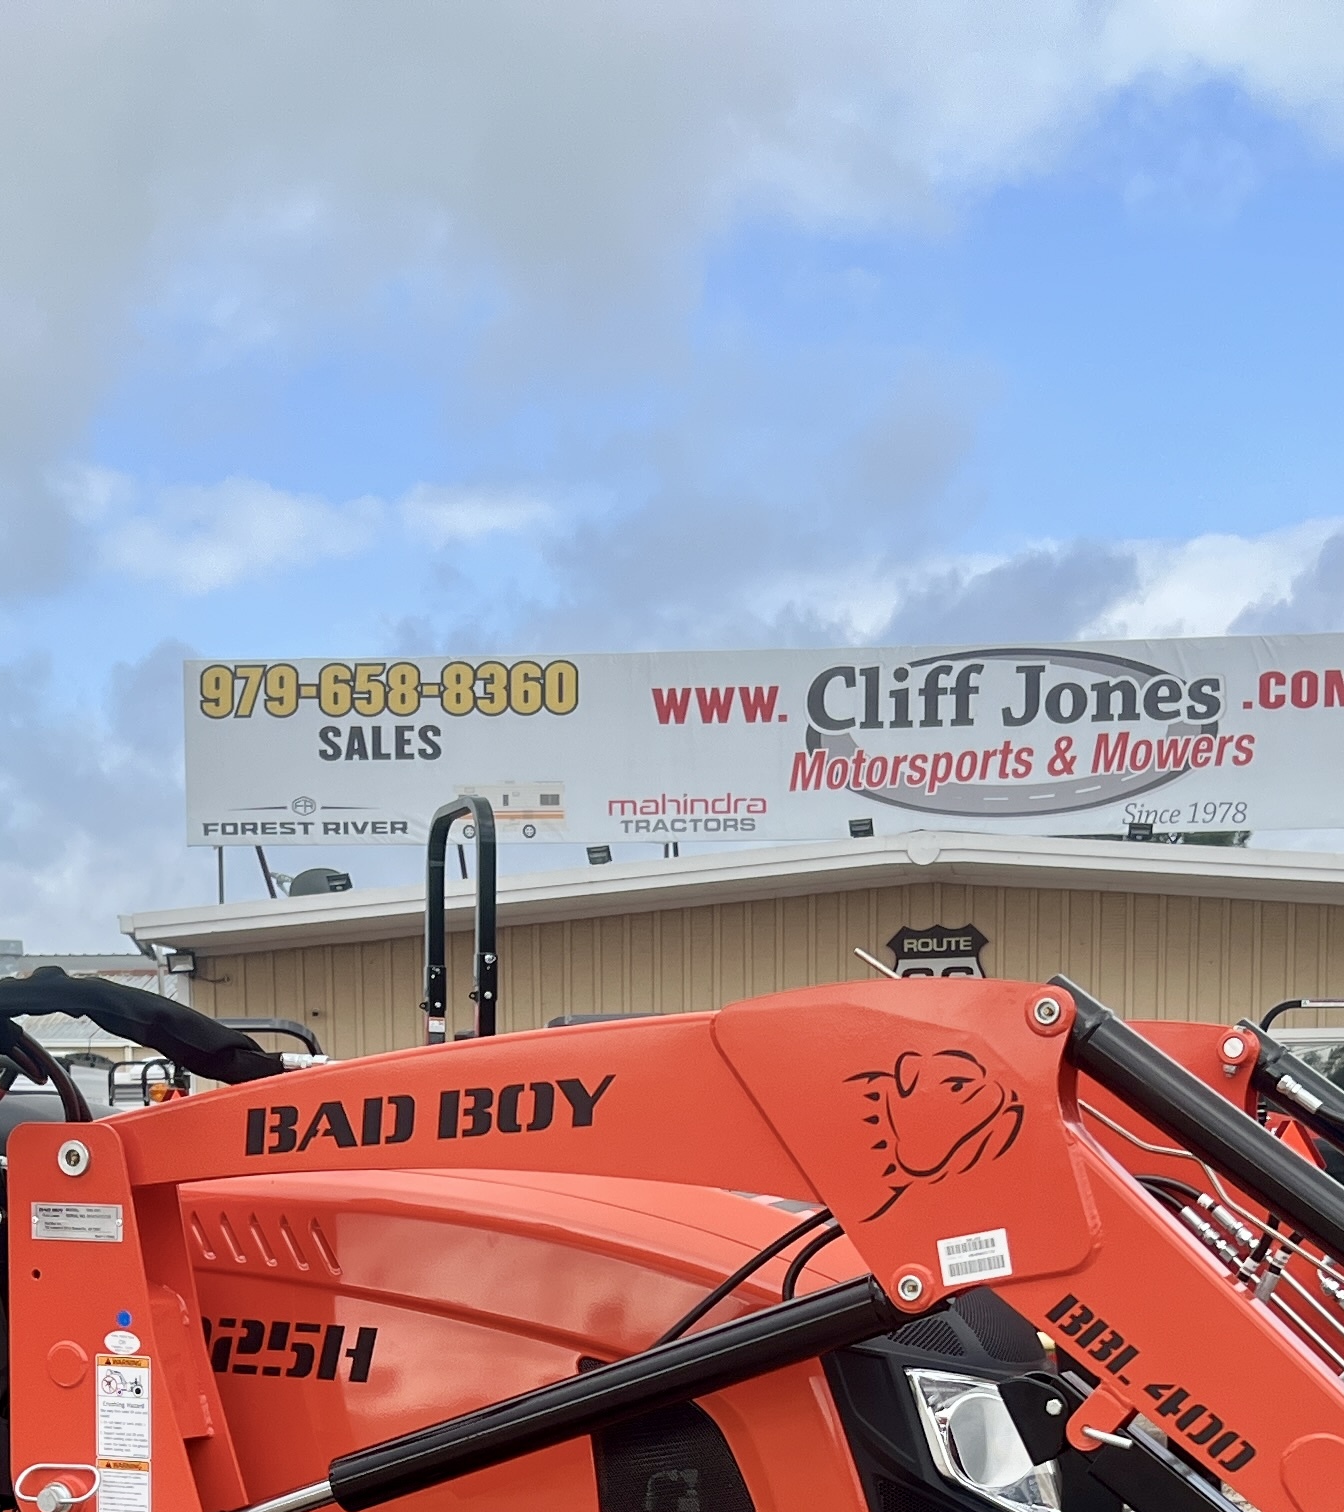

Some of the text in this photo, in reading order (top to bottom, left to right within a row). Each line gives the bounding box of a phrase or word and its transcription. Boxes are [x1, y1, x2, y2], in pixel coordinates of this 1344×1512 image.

[200, 660, 579, 719] 979-658-8360
[807, 663, 985, 731] Cliff
[1001, 664, 1222, 727] Jones
[318, 724, 442, 761] SALES
[789, 730, 1256, 795] Motorsports & Mowers
[608, 793, 766, 817] mahindra
[1122, 801, 1248, 826] Since 1978
[202, 820, 409, 837] FOREST RIVER
[620, 817, 756, 833] TRACTORS
[903, 936, 973, 953] ROUTE
[244, 1074, 617, 1157] BAD BOY
[1142, 1382, 1257, 1473] 400
